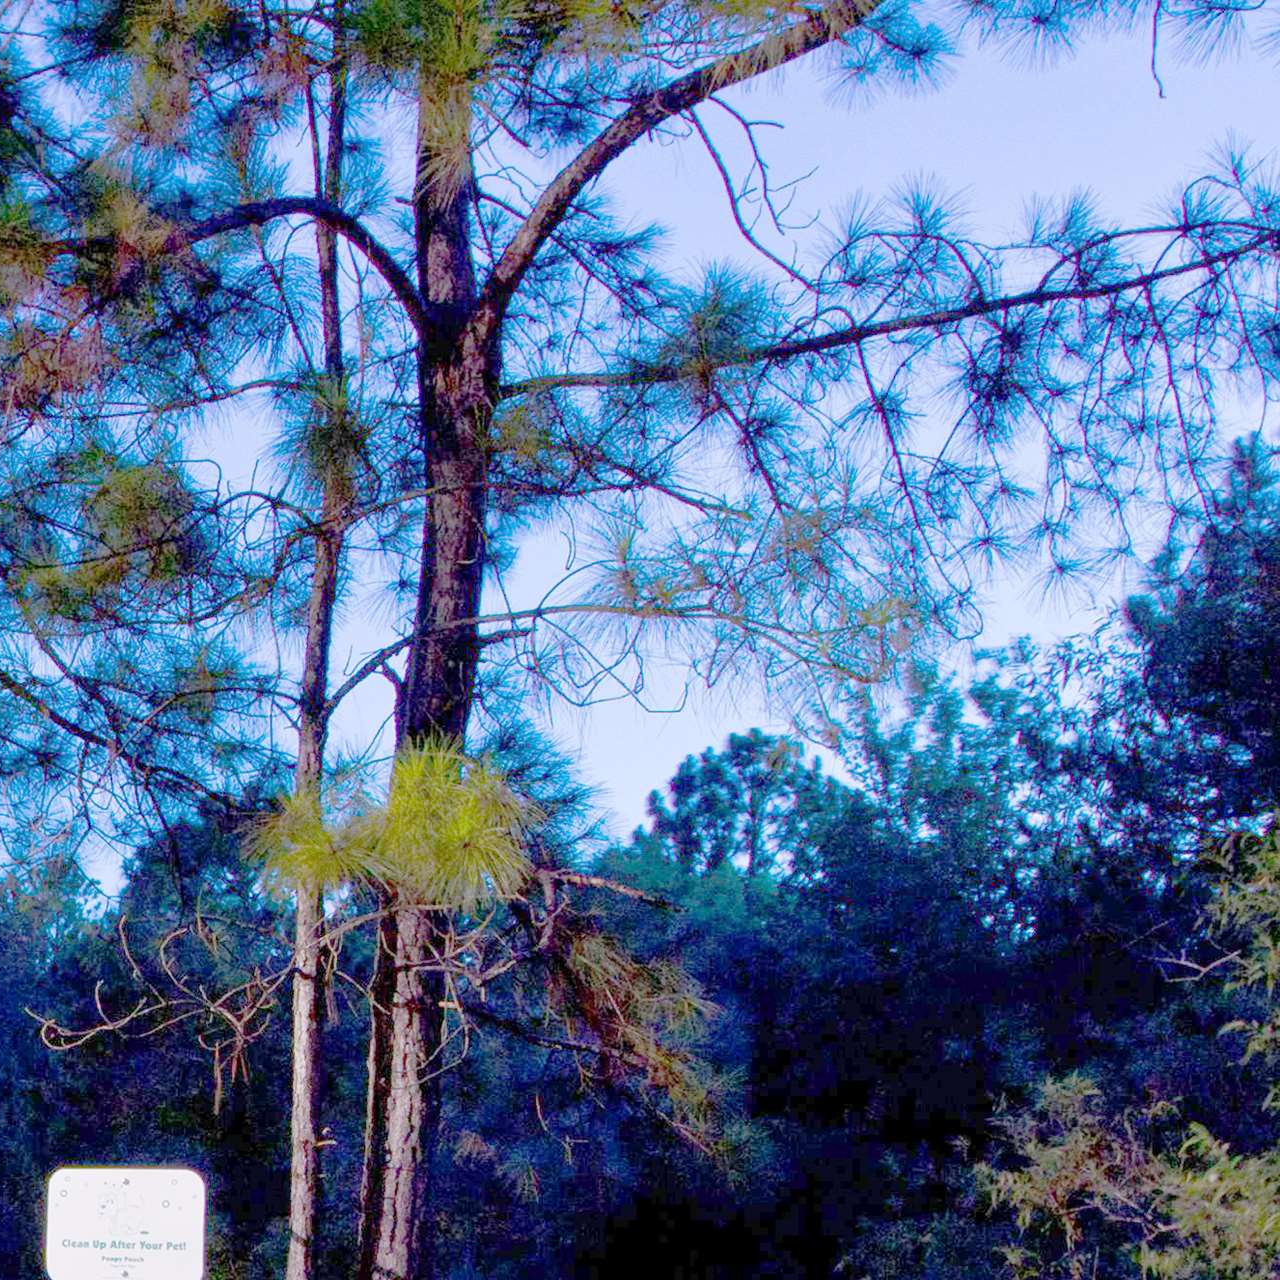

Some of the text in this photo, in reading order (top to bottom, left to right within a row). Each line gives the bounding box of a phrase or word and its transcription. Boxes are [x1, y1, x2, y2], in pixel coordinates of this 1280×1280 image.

[62, 1239, 187, 1251] Clean Up After Your Pet!
